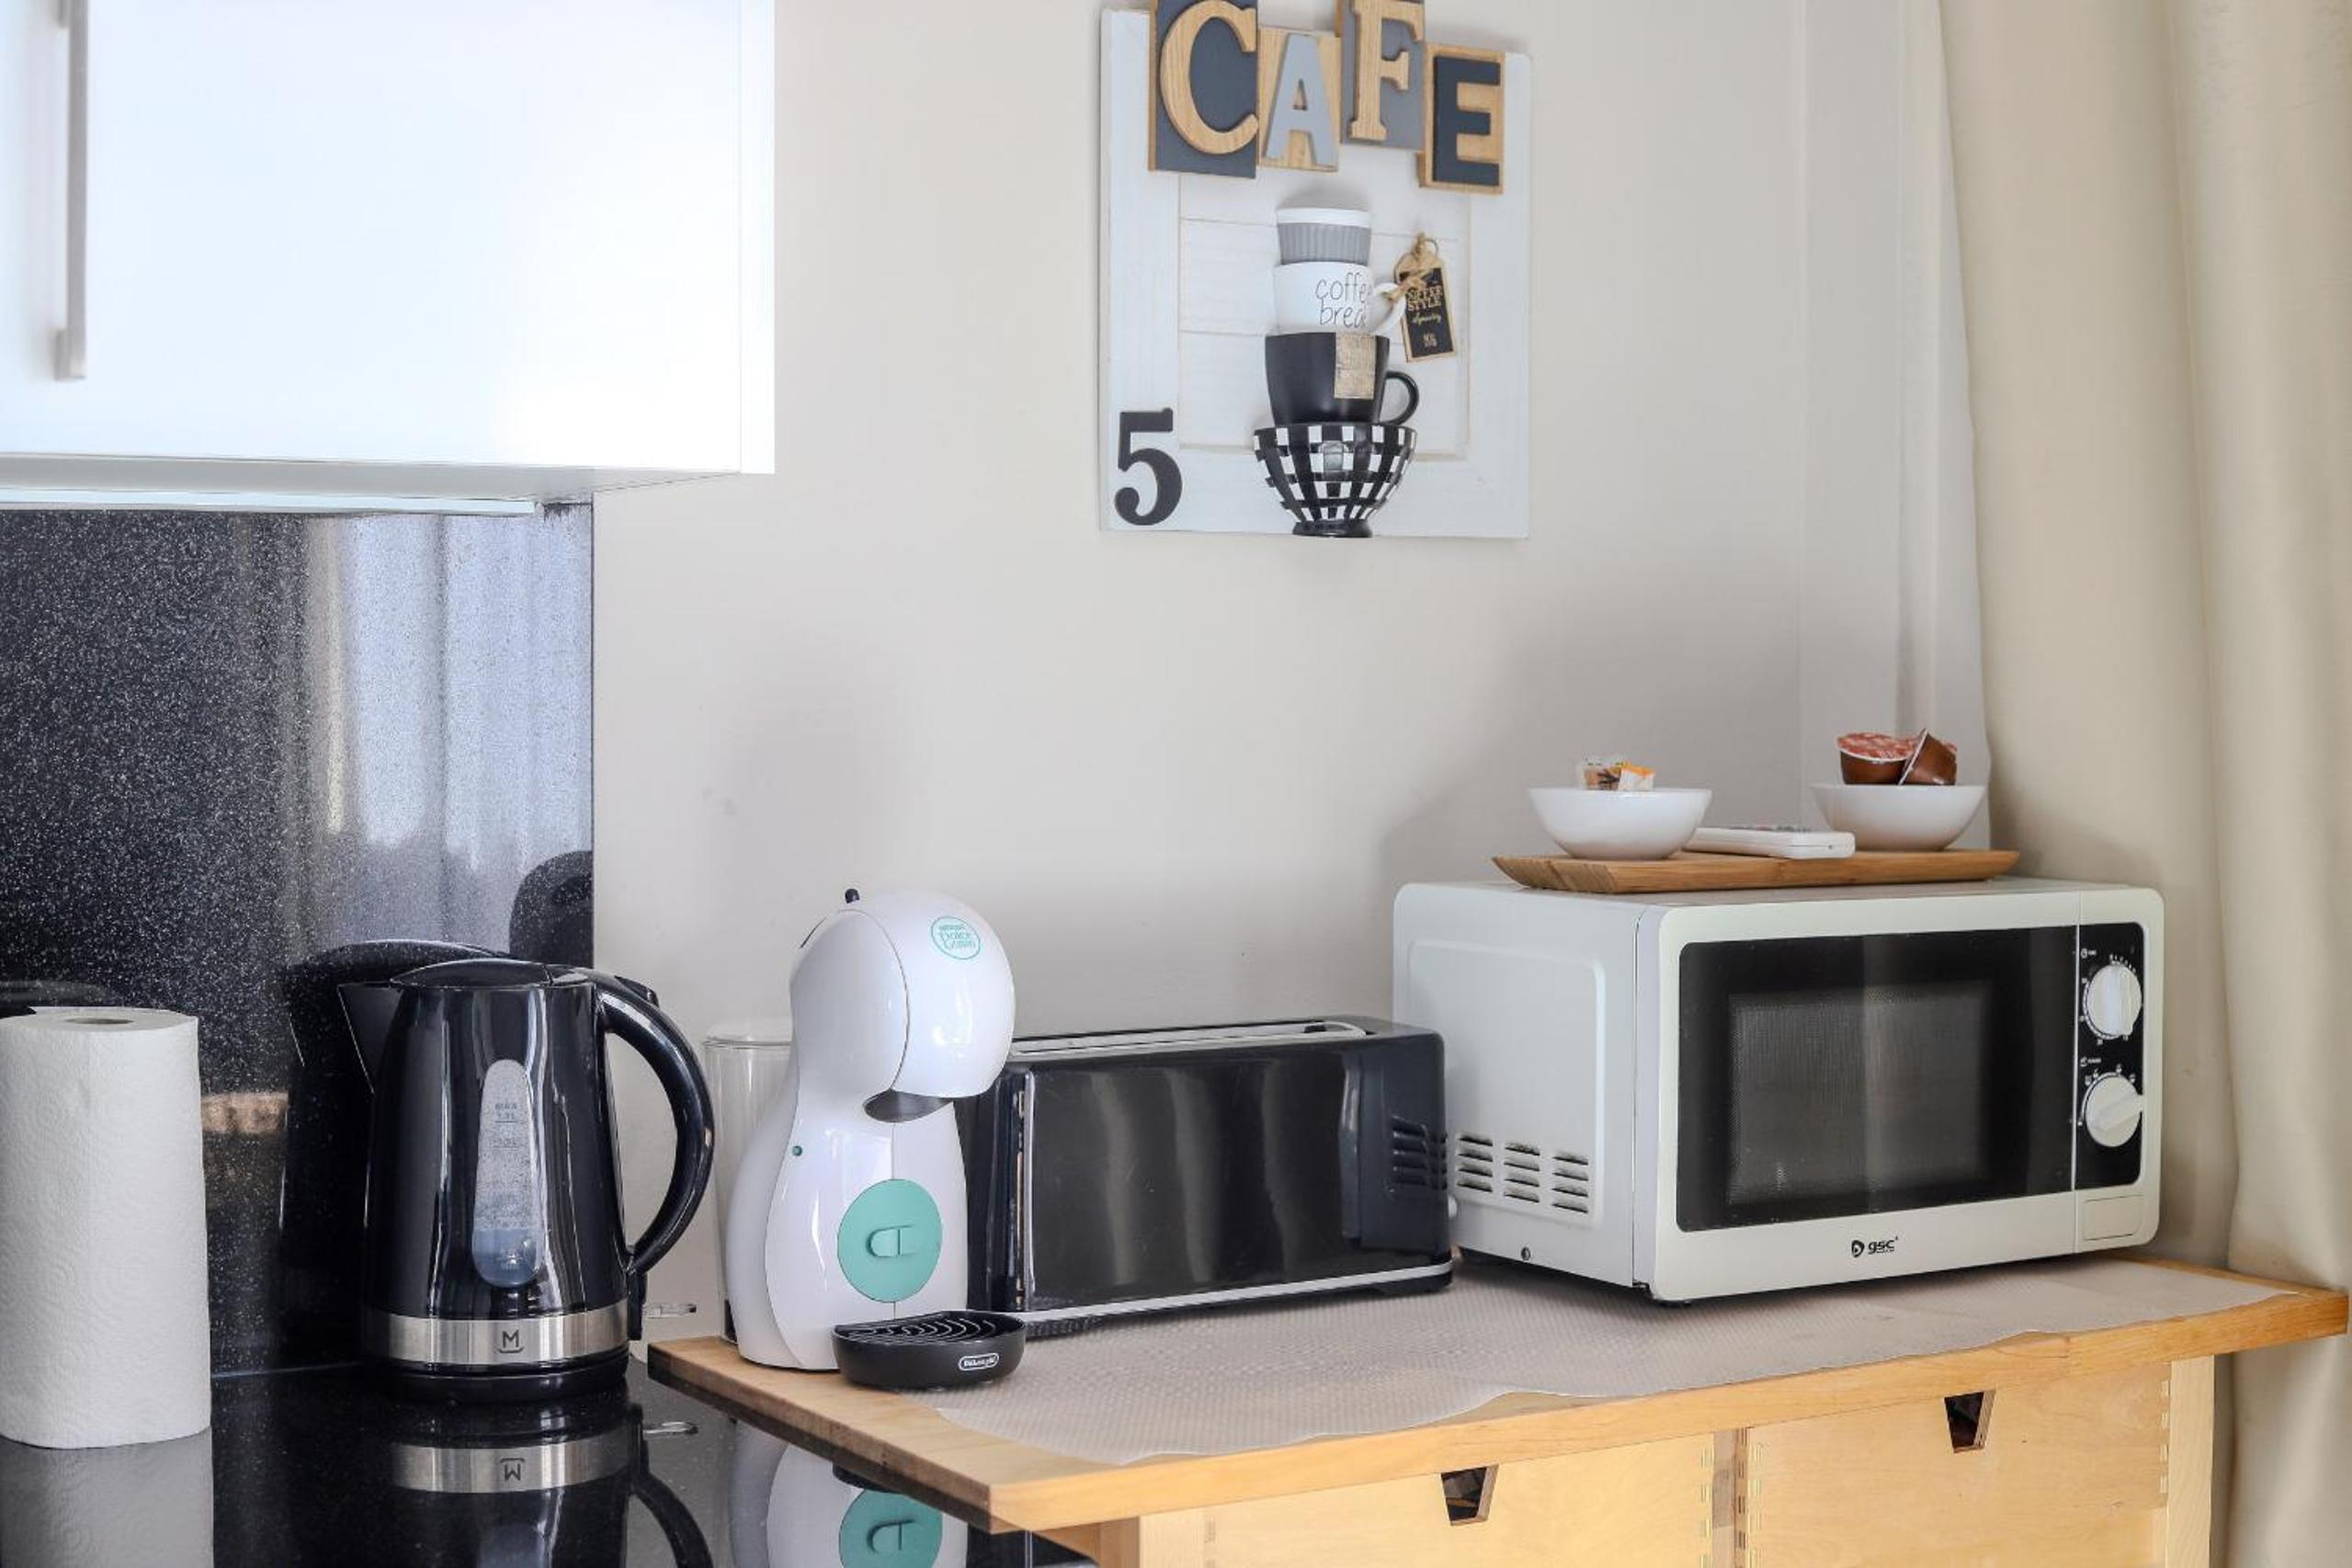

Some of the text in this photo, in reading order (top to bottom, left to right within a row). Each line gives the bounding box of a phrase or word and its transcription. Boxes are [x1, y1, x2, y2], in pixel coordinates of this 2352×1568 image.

[1160, 0, 1502, 187] CAFE
[1319, 299, 1368, 329] brea
[1114, 407, 1183, 527] 5
[502, 1329, 519, 1349] M
